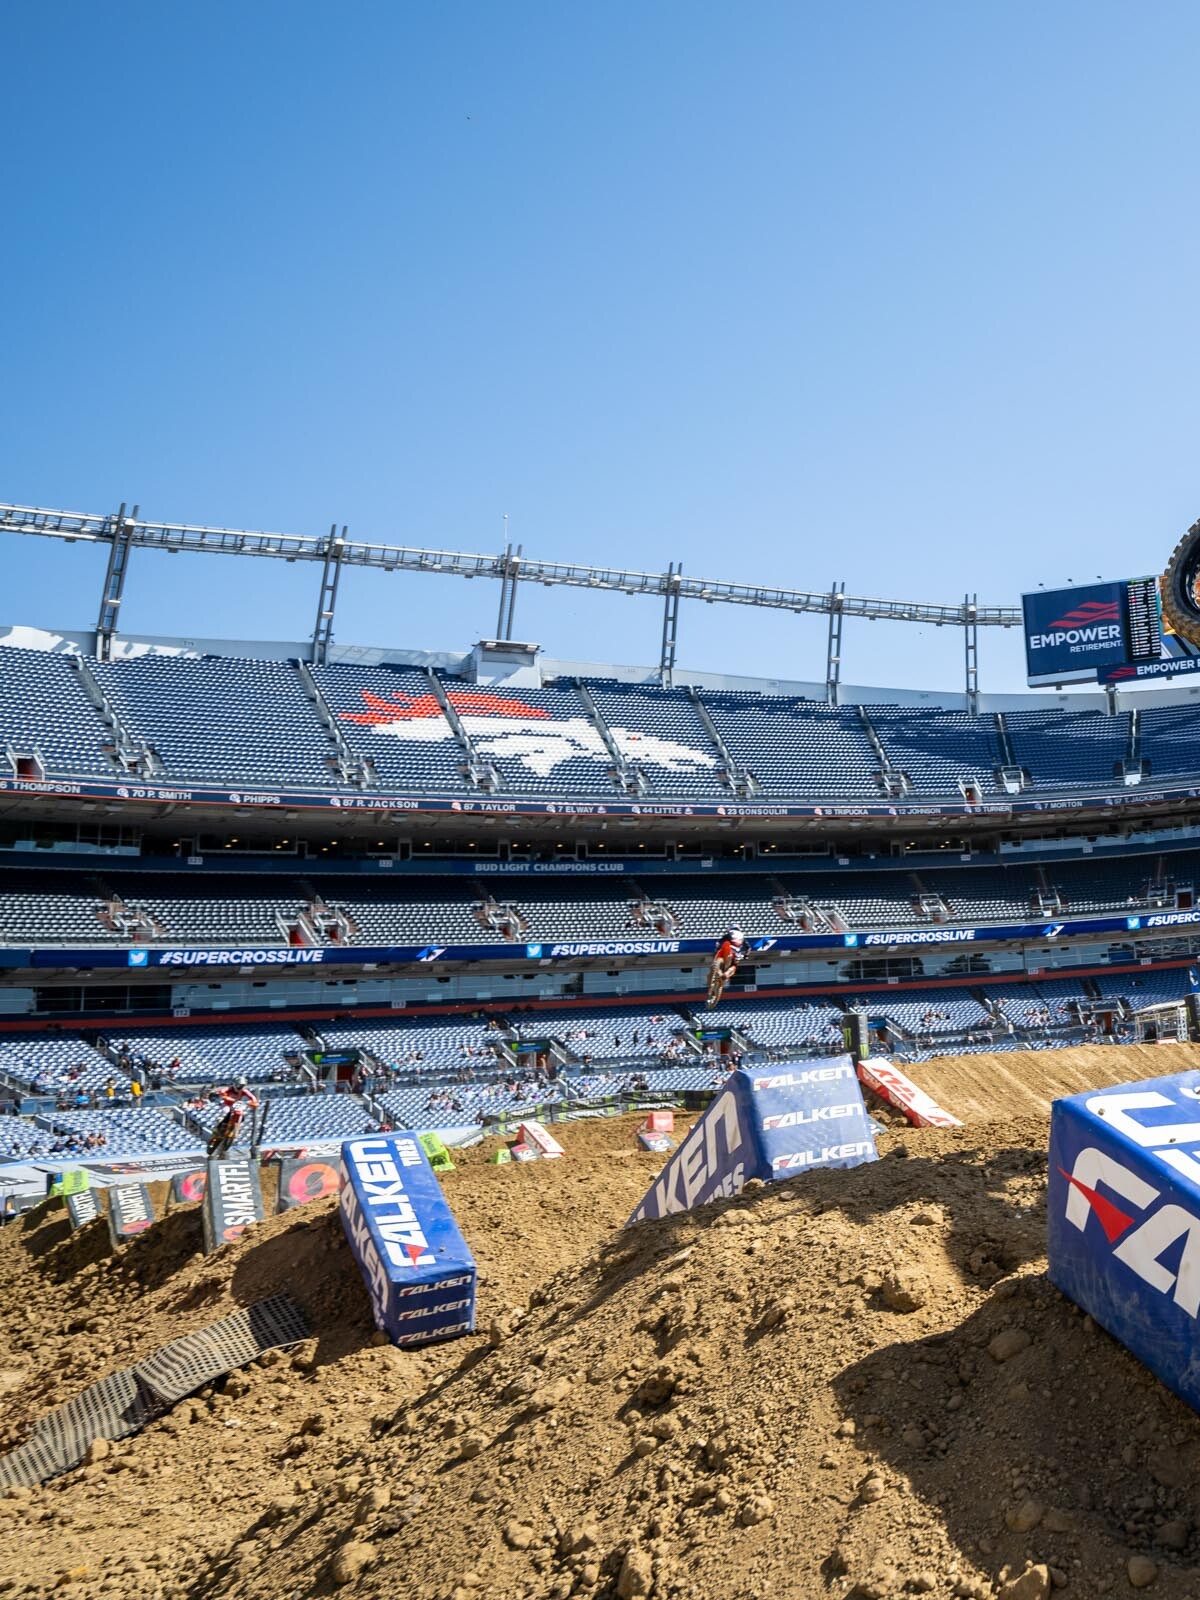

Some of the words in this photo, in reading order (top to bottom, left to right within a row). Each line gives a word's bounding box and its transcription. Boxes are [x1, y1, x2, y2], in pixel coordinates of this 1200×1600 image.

[1029, 625, 1121, 649] EMPOWER
[1136, 659, 1194, 676] EMPOWER
[12, 782, 81, 794] THOMPSON
[132, 789, 145, 798] 70
[147, 790, 156, 798] P.
[158, 791, 192, 800] SMITH
[243, 795, 281, 804] PHIPPS
[342, 799, 354, 807] 87
[356, 800, 366, 808] R.
[367, 800, 419, 809] JACKSON
[480, 803, 516, 812] TAYLOR
[654, 807, 682, 815] LITTLE
[983, 805, 1010, 813] TURNER
[475, 863, 498, 872] BUD
[499, 863, 530, 872] LIGHT
[533, 863, 597, 872] CHAMPIONS
[597, 863, 624, 872] CLUB
[865, 930, 975, 944] #SUPERCROSSLIVE
[551, 941, 679, 955] #SUPERCROSSLIVE
[159, 950, 324, 965] #SUPERCROSSLIVE
[753, 1066, 853, 1091] FALKEN
[762, 1103, 863, 1130] FALKEN
[772, 1141, 874, 1171] FALKEN
[349, 1139, 436, 1267] FALKEN
[398, 1274, 472, 1297] FALKEN
[398, 1298, 471, 1321] FALKEN
[397, 1321, 470, 1344] FALKEN
